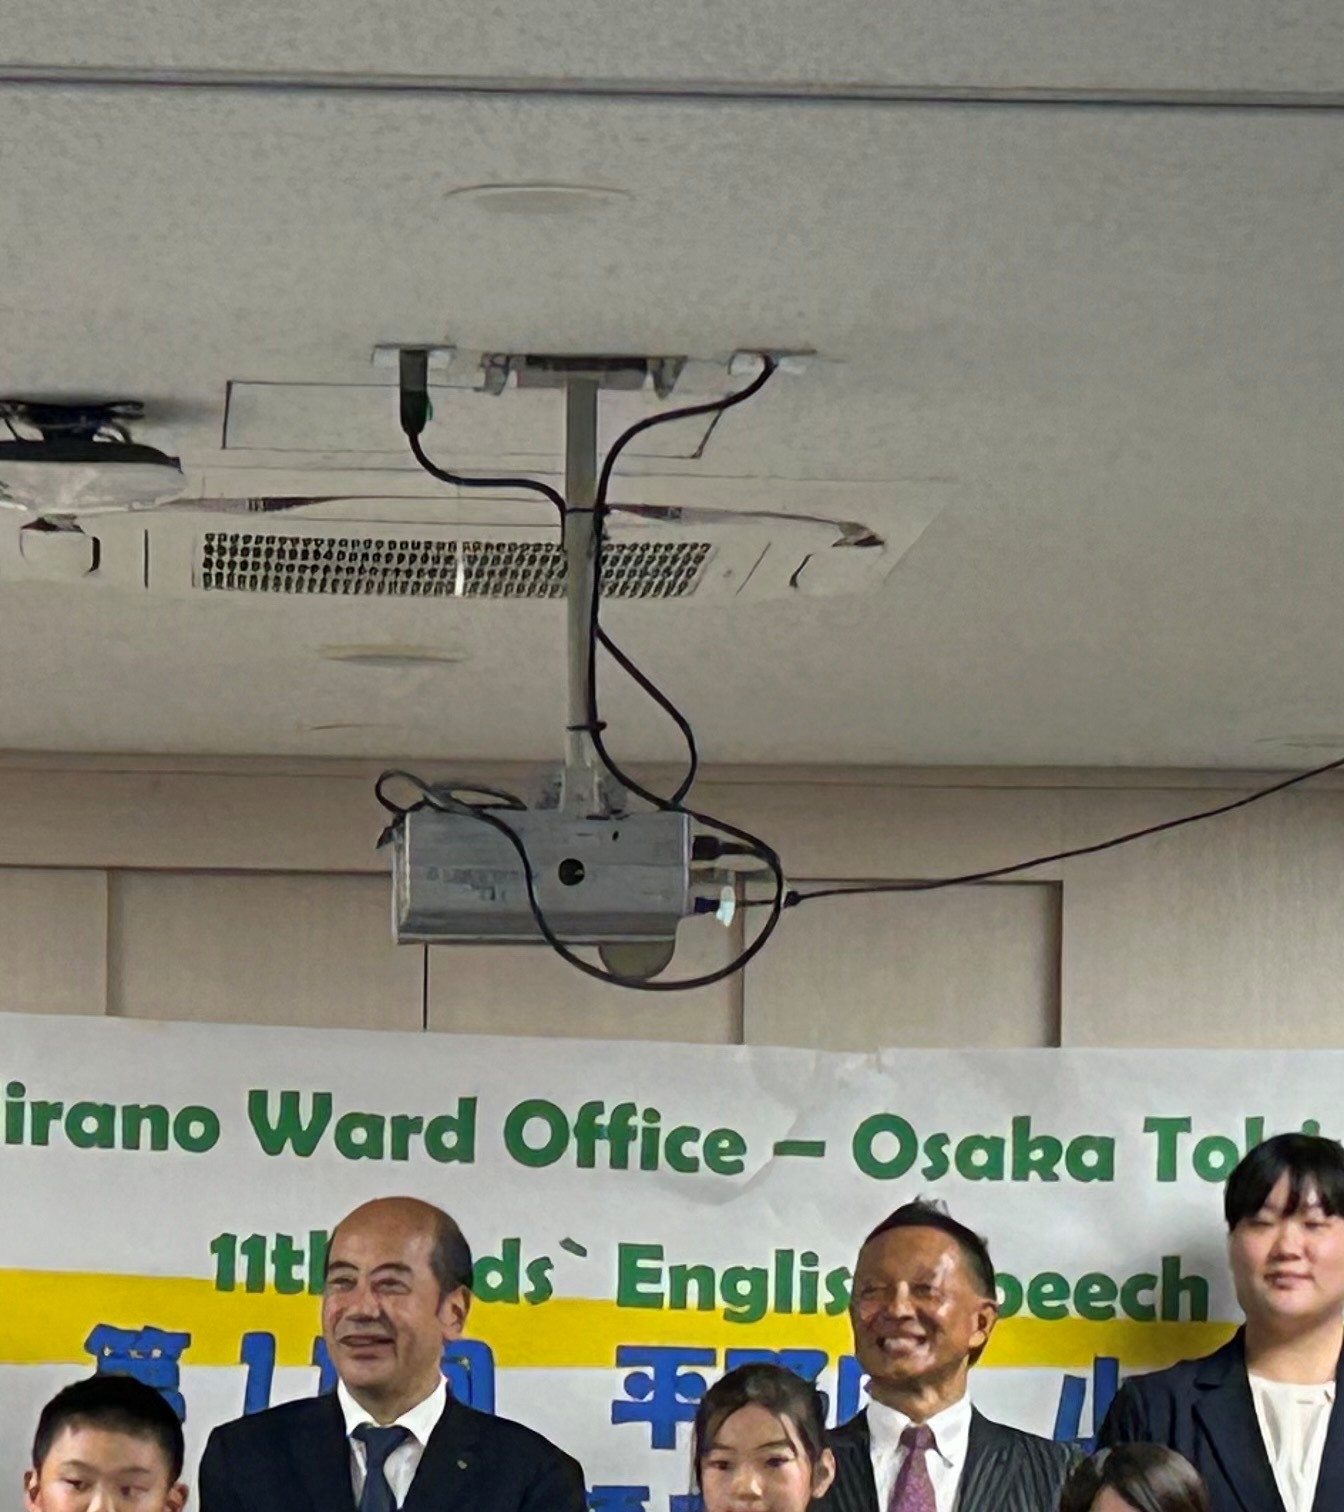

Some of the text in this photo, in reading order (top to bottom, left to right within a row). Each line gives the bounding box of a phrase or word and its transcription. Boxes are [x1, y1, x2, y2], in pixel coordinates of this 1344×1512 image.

[248, 1089, 476, 1164] Ward
[503, 1100, 747, 1175] Office
[853, 1113, 1115, 1182] Osaka
[616, 1245, 855, 1323] Englis
